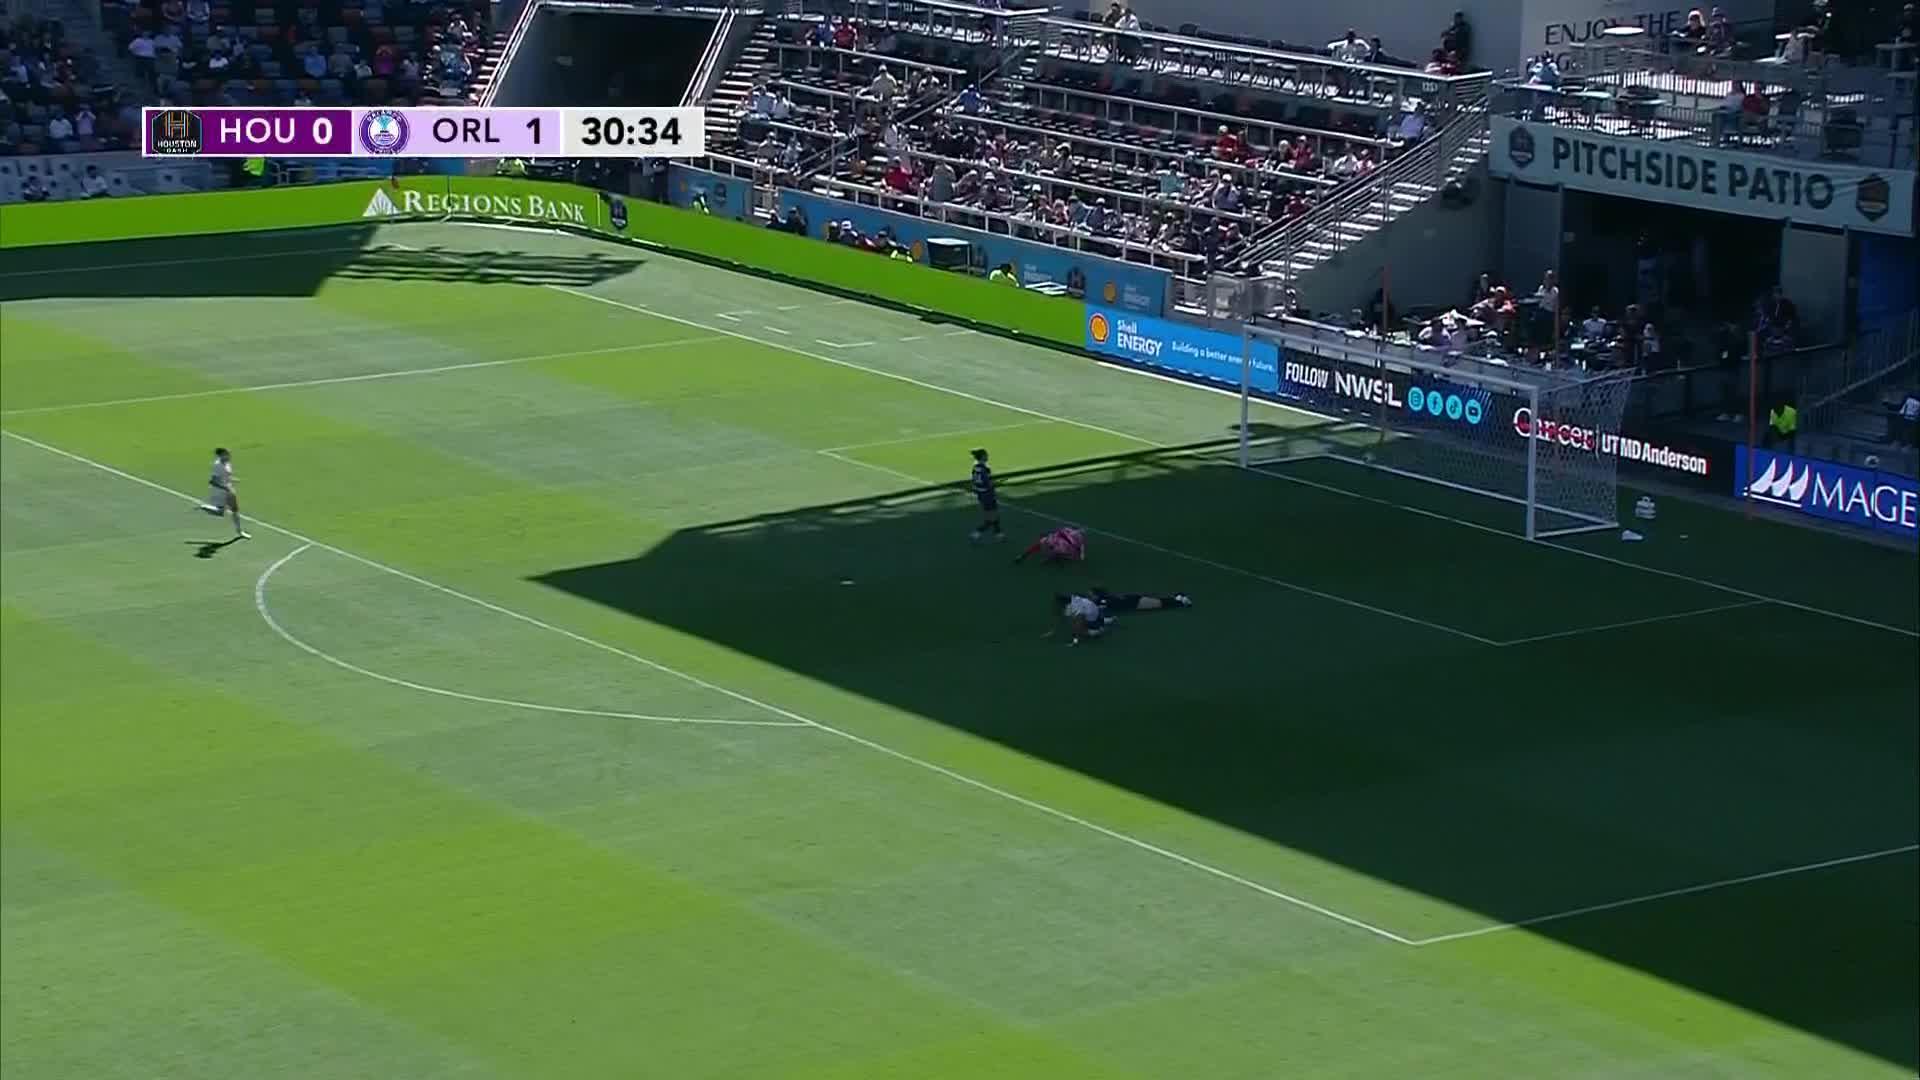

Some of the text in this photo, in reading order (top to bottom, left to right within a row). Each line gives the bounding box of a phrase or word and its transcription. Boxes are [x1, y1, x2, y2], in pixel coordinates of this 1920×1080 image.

[1636, 10, 1681, 38] THE
[1552, 136, 1834, 210] PITCHSIDE PATIO
[403, 190, 585, 223] REGIONS BANK
[1117, 319, 1137, 334] Shell
[1117, 332, 1163, 357] ENERGY
[1199, 349, 1205, 357] a
[1206, 347, 1227, 361] better
[1285, 362, 1402, 408] FOLLOW NWSL
[1602, 433, 1620, 454] UT
[1620, 437, 1641, 459] MD
[1642, 447, 1707, 476] Anderson
[1812, 471, 1918, 528] MAGE
